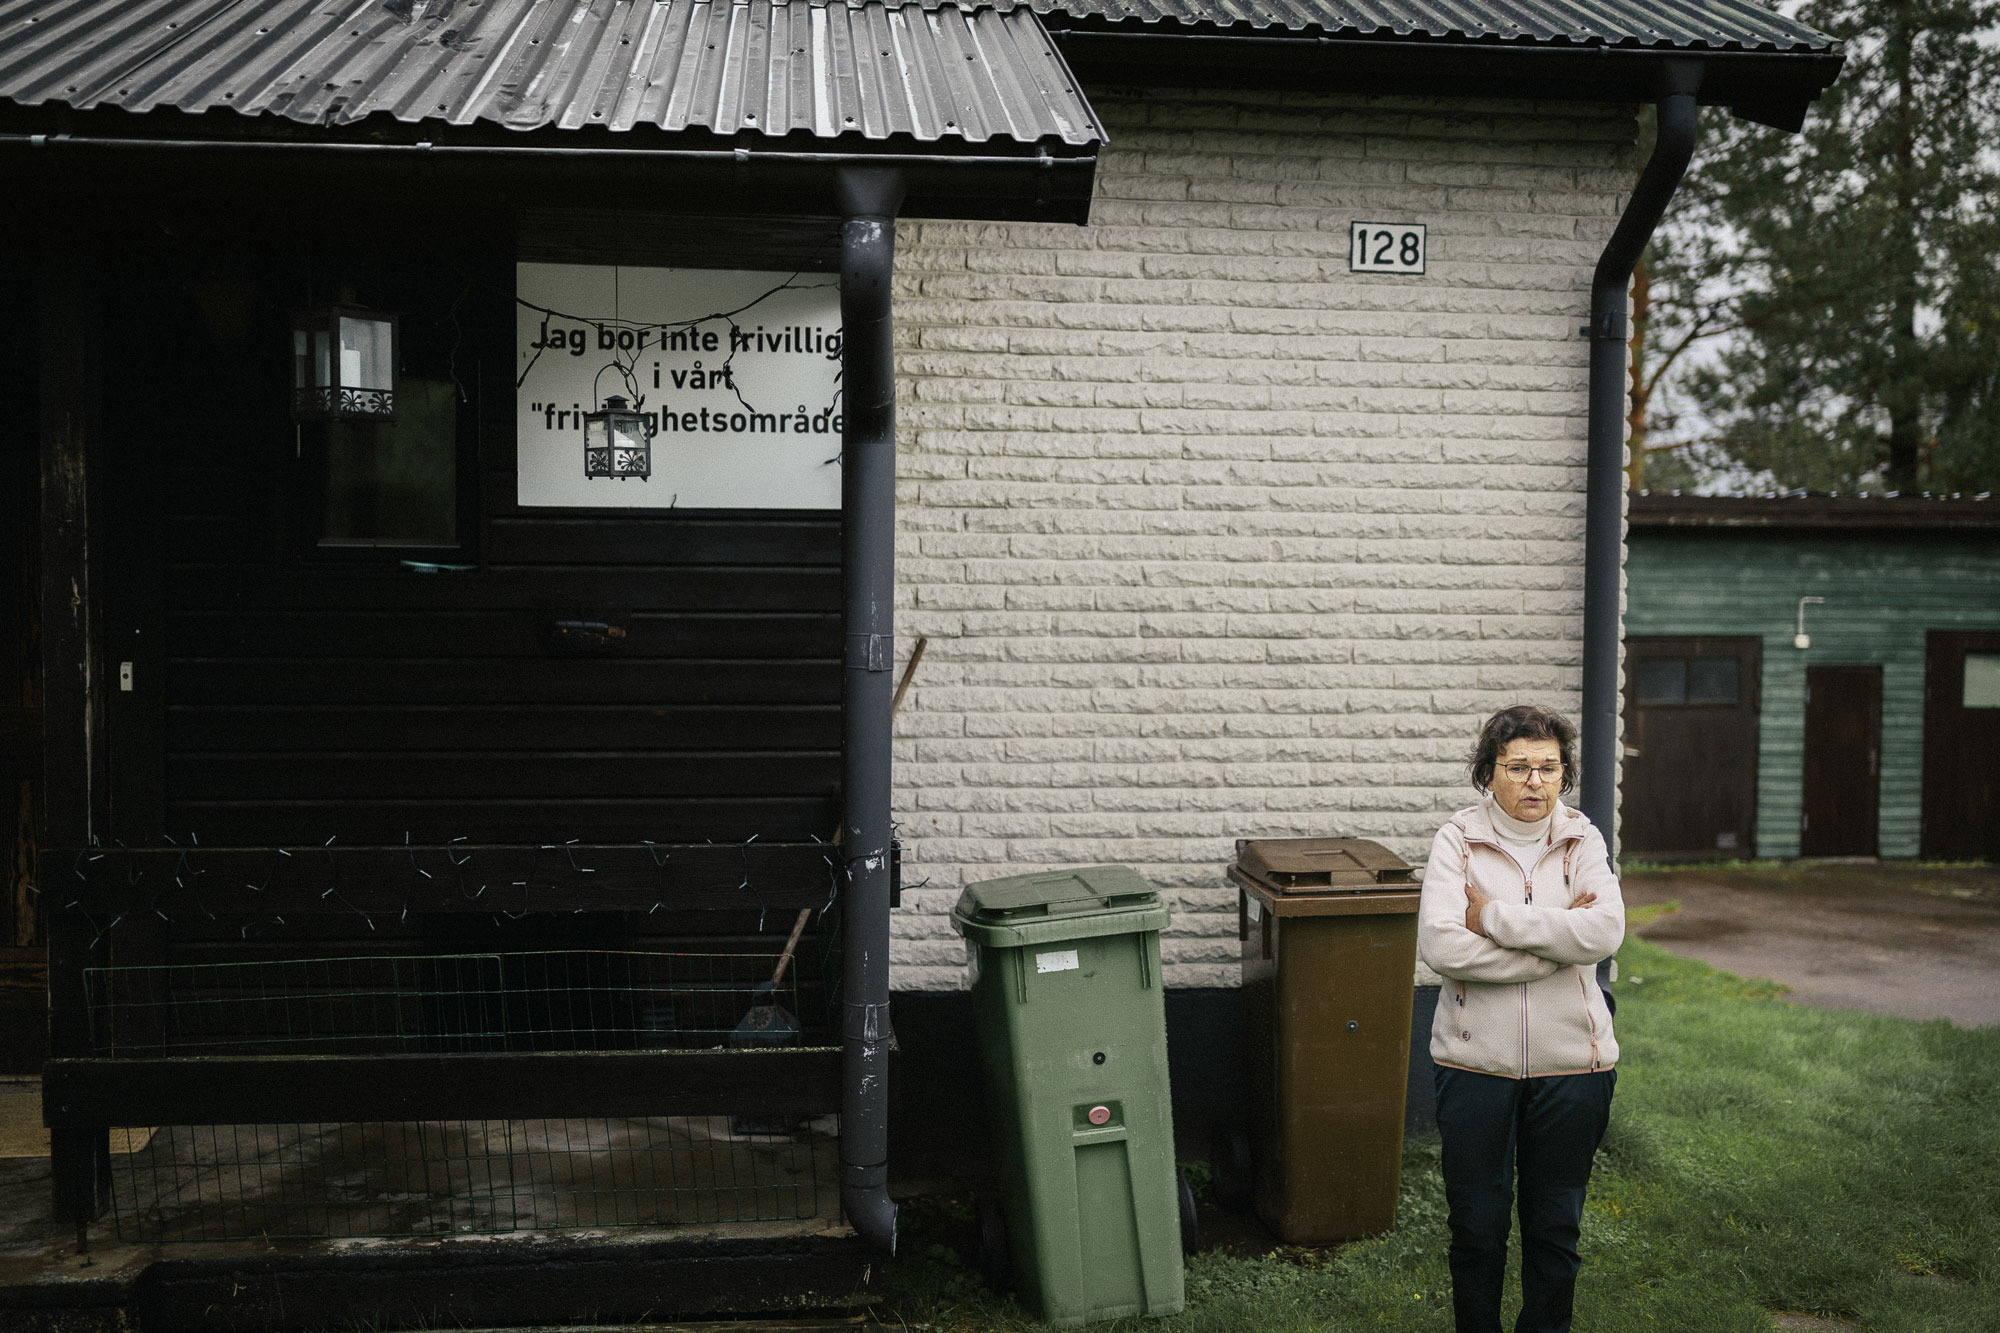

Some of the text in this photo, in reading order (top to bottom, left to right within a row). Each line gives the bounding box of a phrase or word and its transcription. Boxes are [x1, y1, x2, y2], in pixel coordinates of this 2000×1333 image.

[1358, 229, 1419, 266] 128
[531, 322, 586, 356] Jag
[599, 323, 650, 351] bor
[661, 326, 719, 352] inte
[653, 360, 734, 390] i vårt
